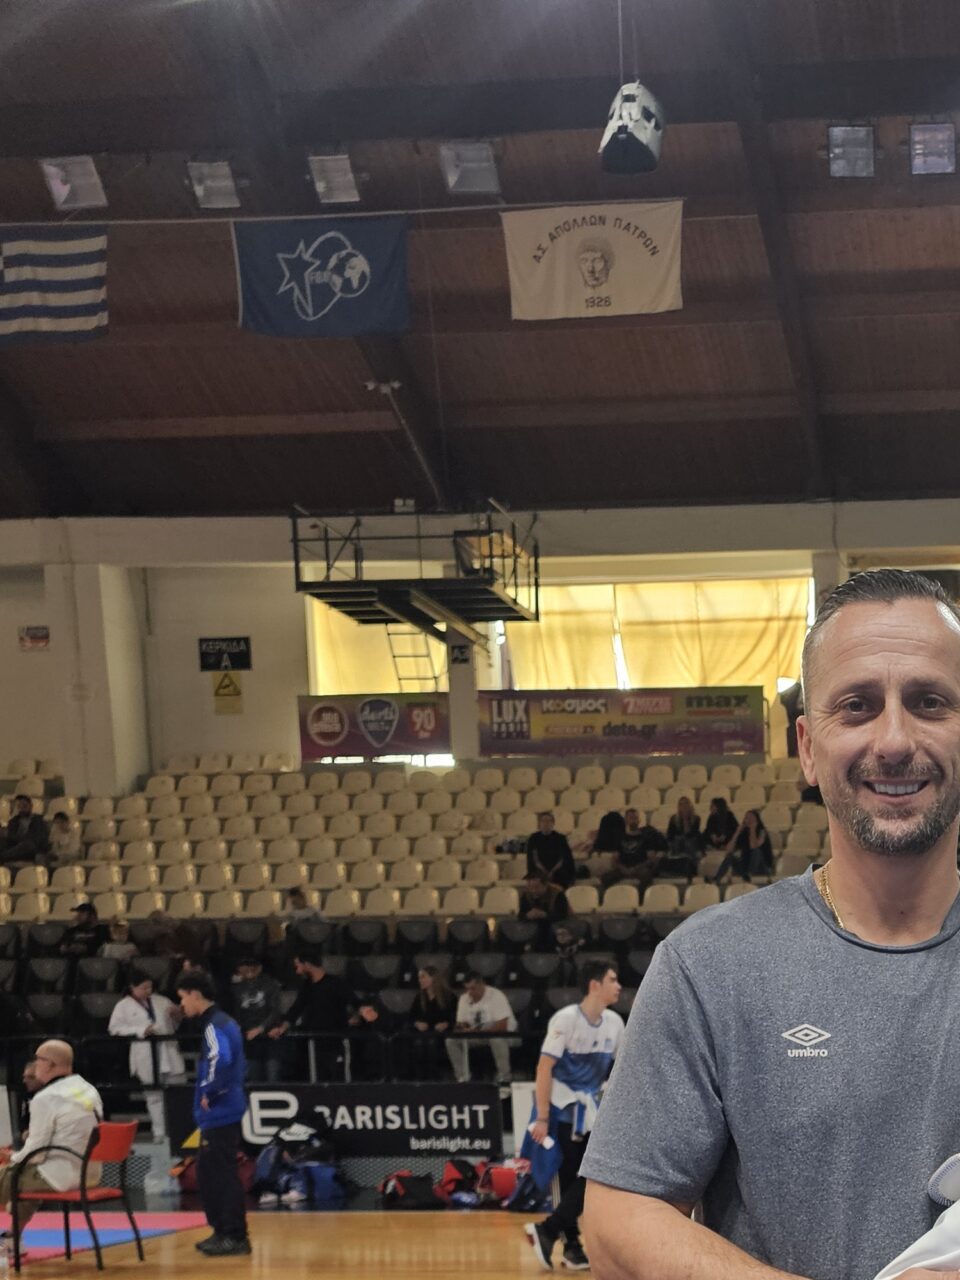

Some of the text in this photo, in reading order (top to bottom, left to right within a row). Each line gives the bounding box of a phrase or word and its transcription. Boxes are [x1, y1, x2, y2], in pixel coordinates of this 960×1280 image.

[547, 214, 608, 244] ΑΠΟΛΛΩΝ
[612, 216, 660, 257] ΠΑΤΡΩΝ
[584, 296, 612, 309] 1926
[685, 695, 748, 707] max
[492, 699, 527, 723] LUX
[412, 709, 435, 731] 90
[787, 1047, 828, 1058] umbro
[409, 1136, 491, 1153] barislight.eu
